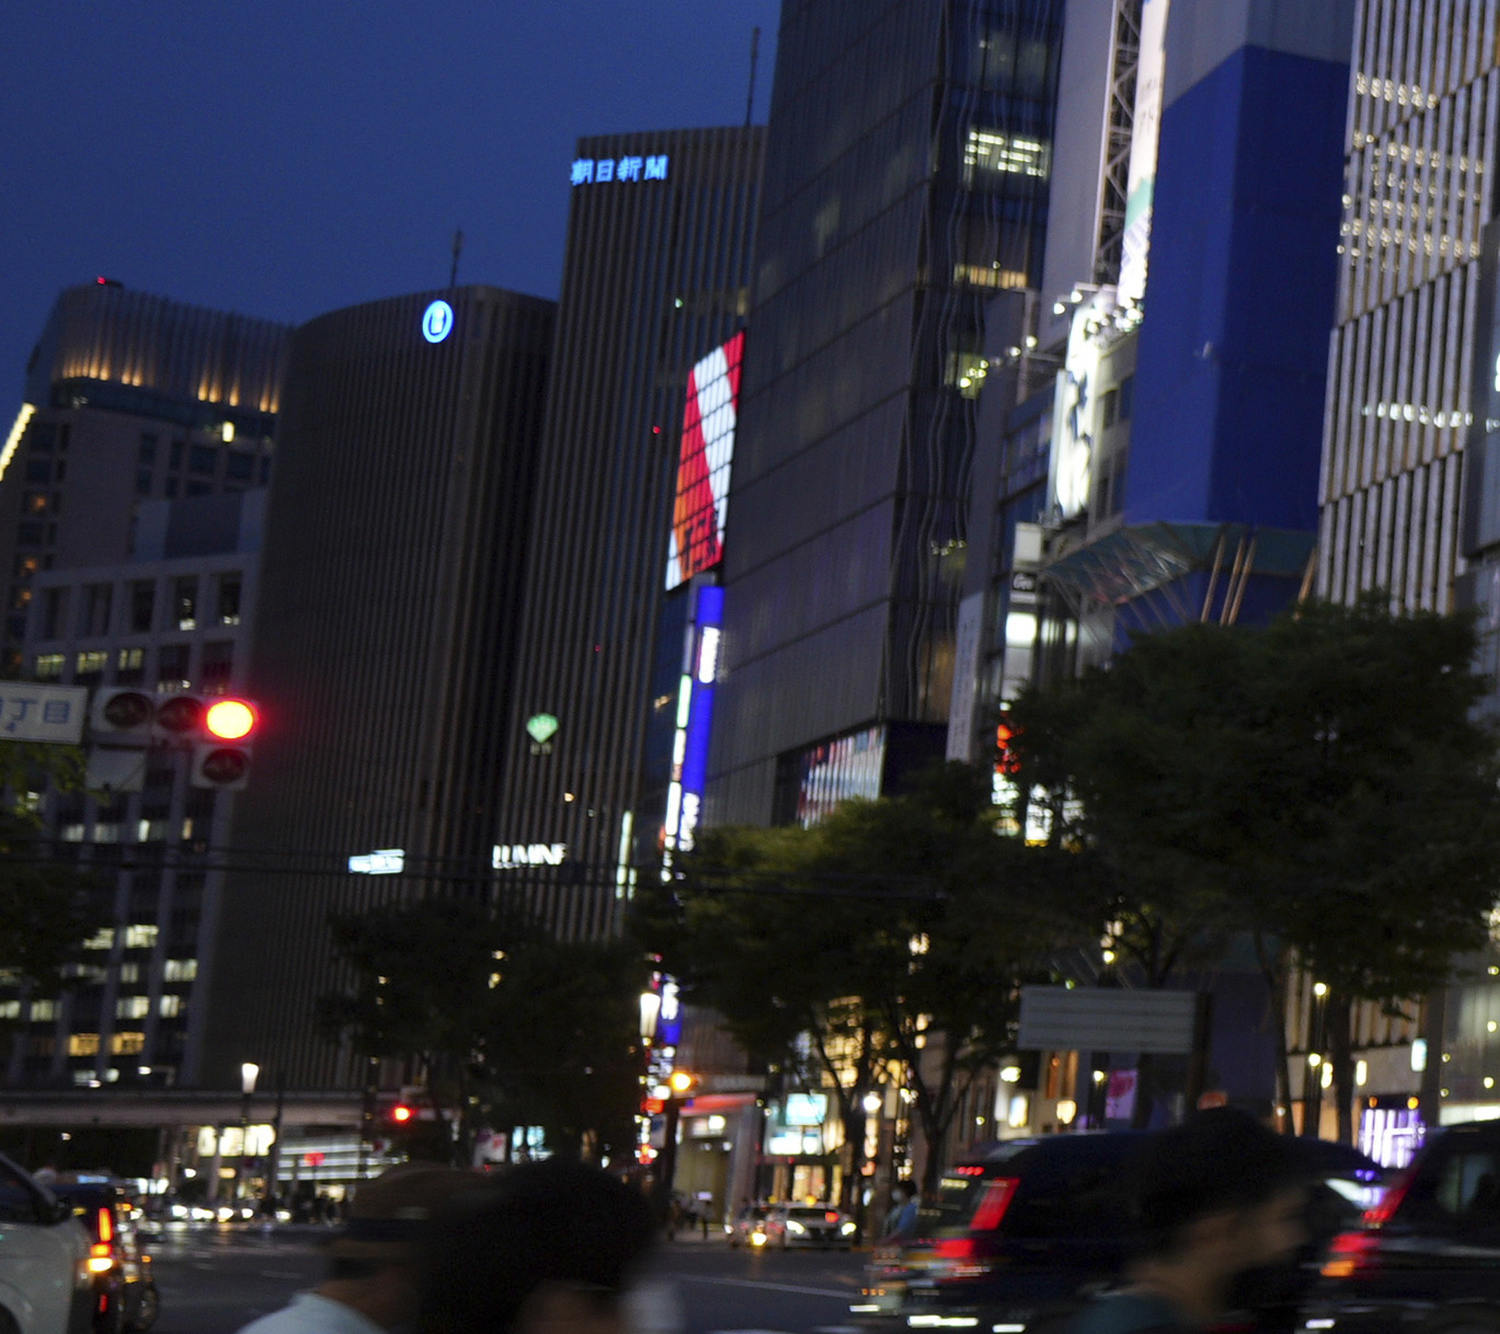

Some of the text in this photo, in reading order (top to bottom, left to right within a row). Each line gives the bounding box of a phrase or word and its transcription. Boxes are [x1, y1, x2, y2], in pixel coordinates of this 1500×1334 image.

[570, 154, 669, 186] 朝日新聞
[0, 697, 72, 725] 丁目
